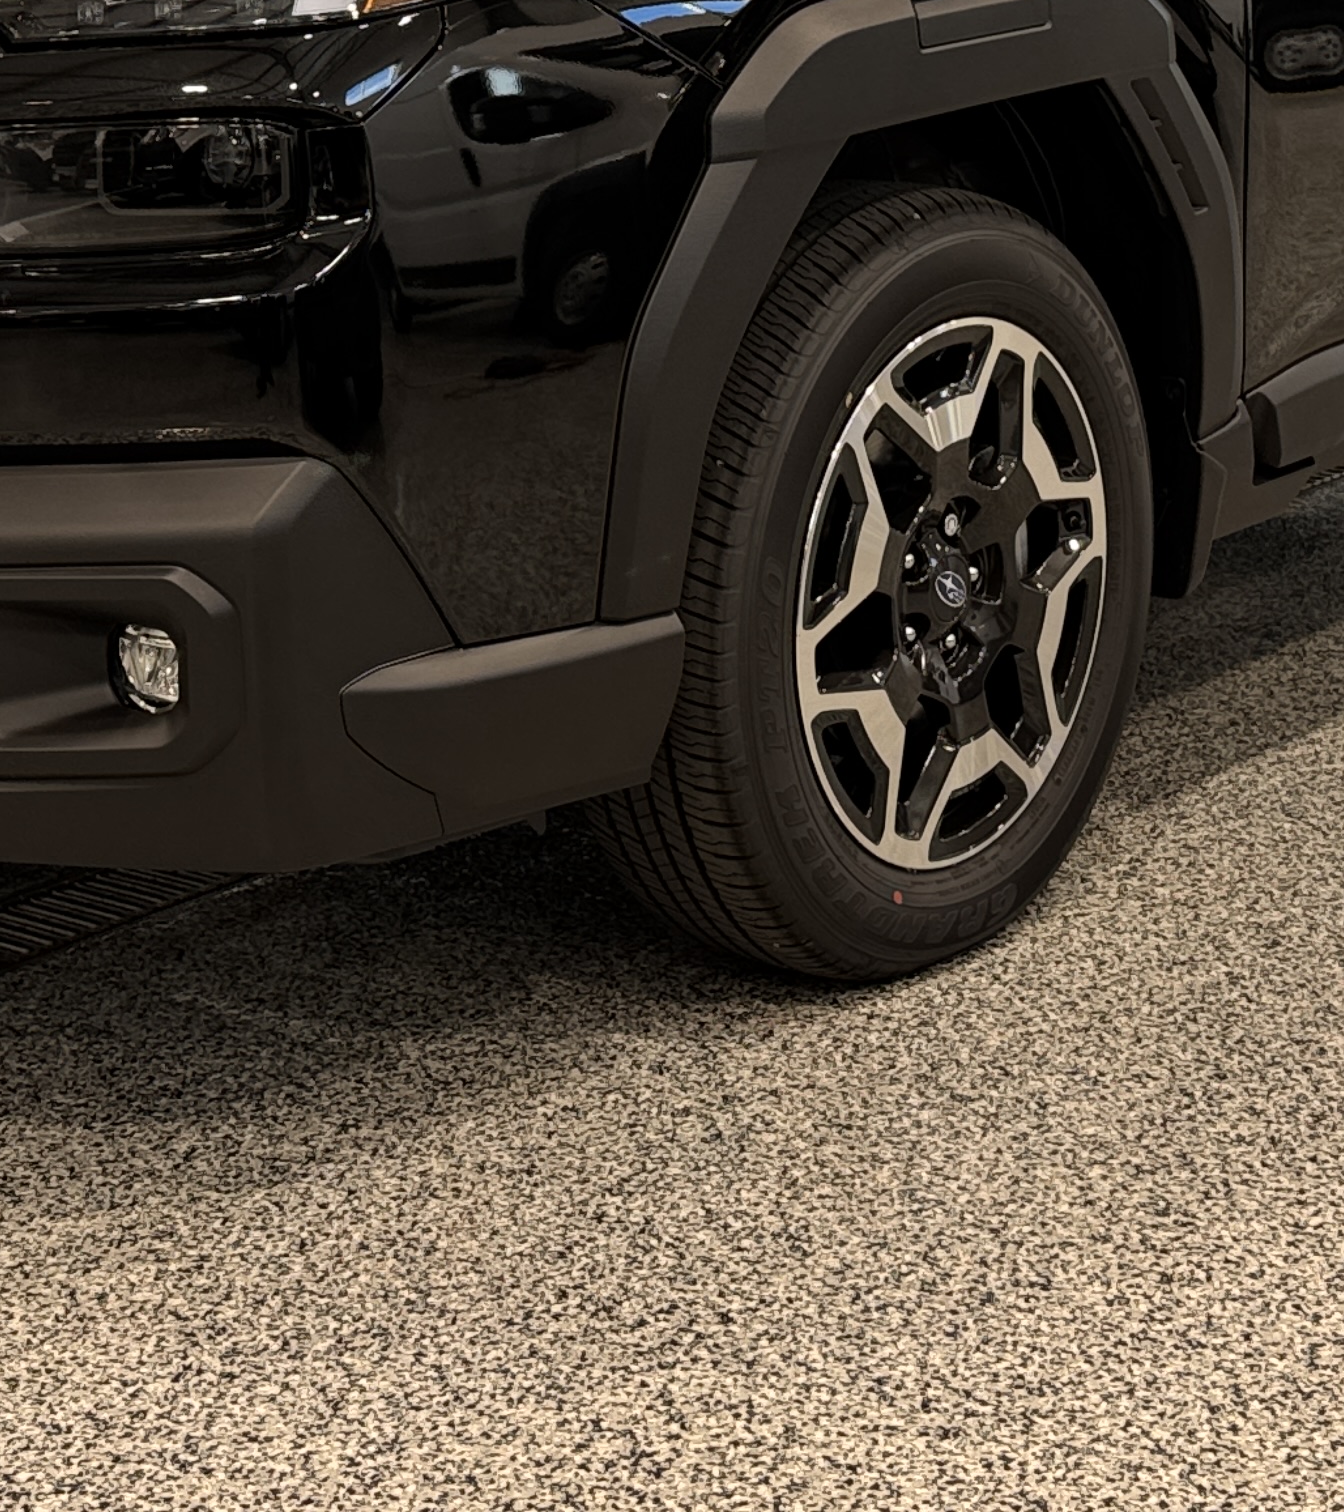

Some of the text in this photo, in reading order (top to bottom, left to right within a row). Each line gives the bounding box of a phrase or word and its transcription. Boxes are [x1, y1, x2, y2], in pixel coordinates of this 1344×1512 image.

[1049, 273, 1145, 457] DUNLOP
[754, 556, 787, 754] PT20
[774, 783, 1018, 946] GRANDTREK
